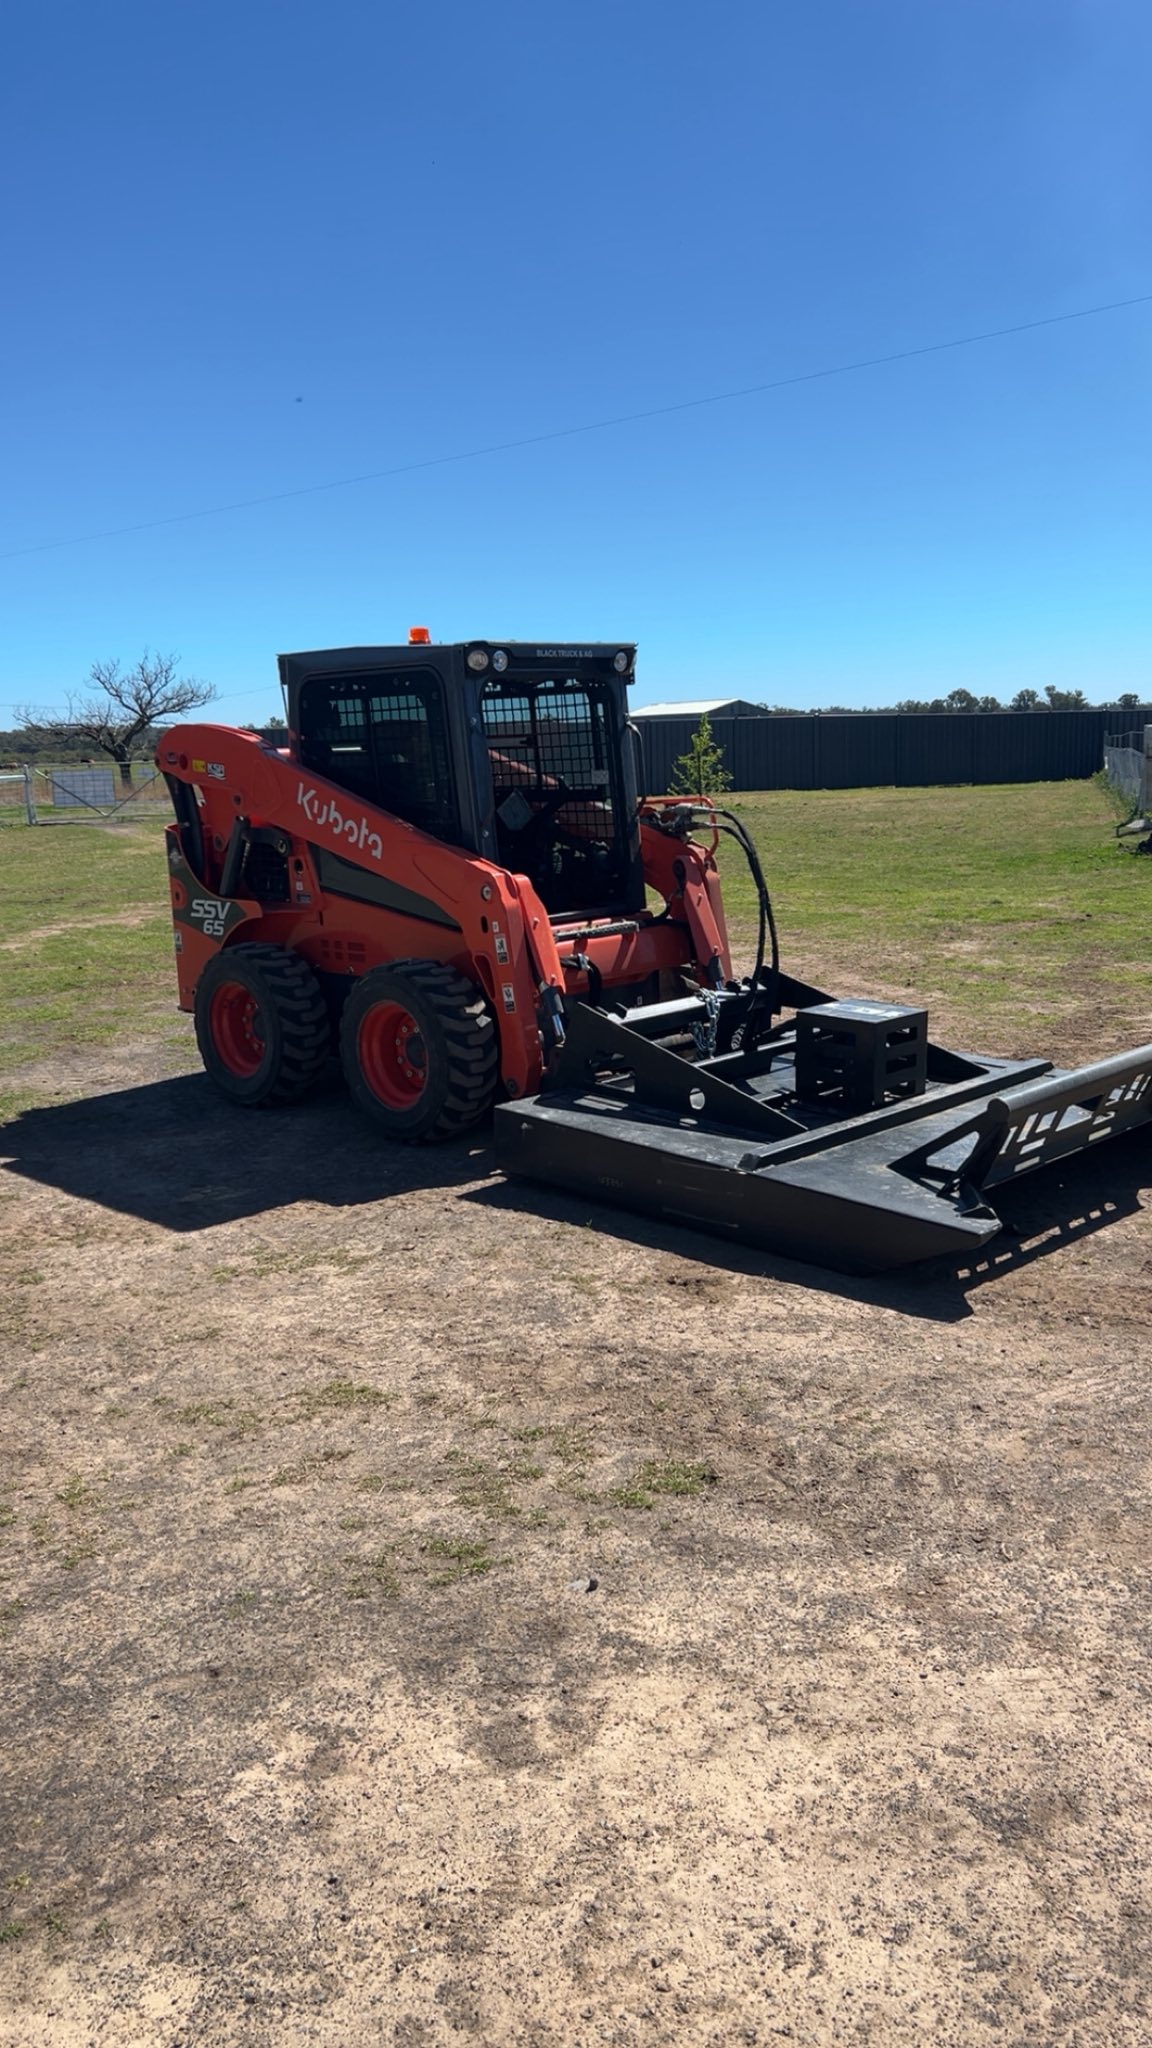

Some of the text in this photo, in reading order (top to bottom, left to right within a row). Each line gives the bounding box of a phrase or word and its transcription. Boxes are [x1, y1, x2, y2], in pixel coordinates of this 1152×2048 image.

[536, 649, 558, 658] BLACK
[558, 649, 579, 658] TRUCK
[297, 782, 383, 859] Kubota
[190, 899, 231, 920] SSV
[203, 919, 225, 936] 65
